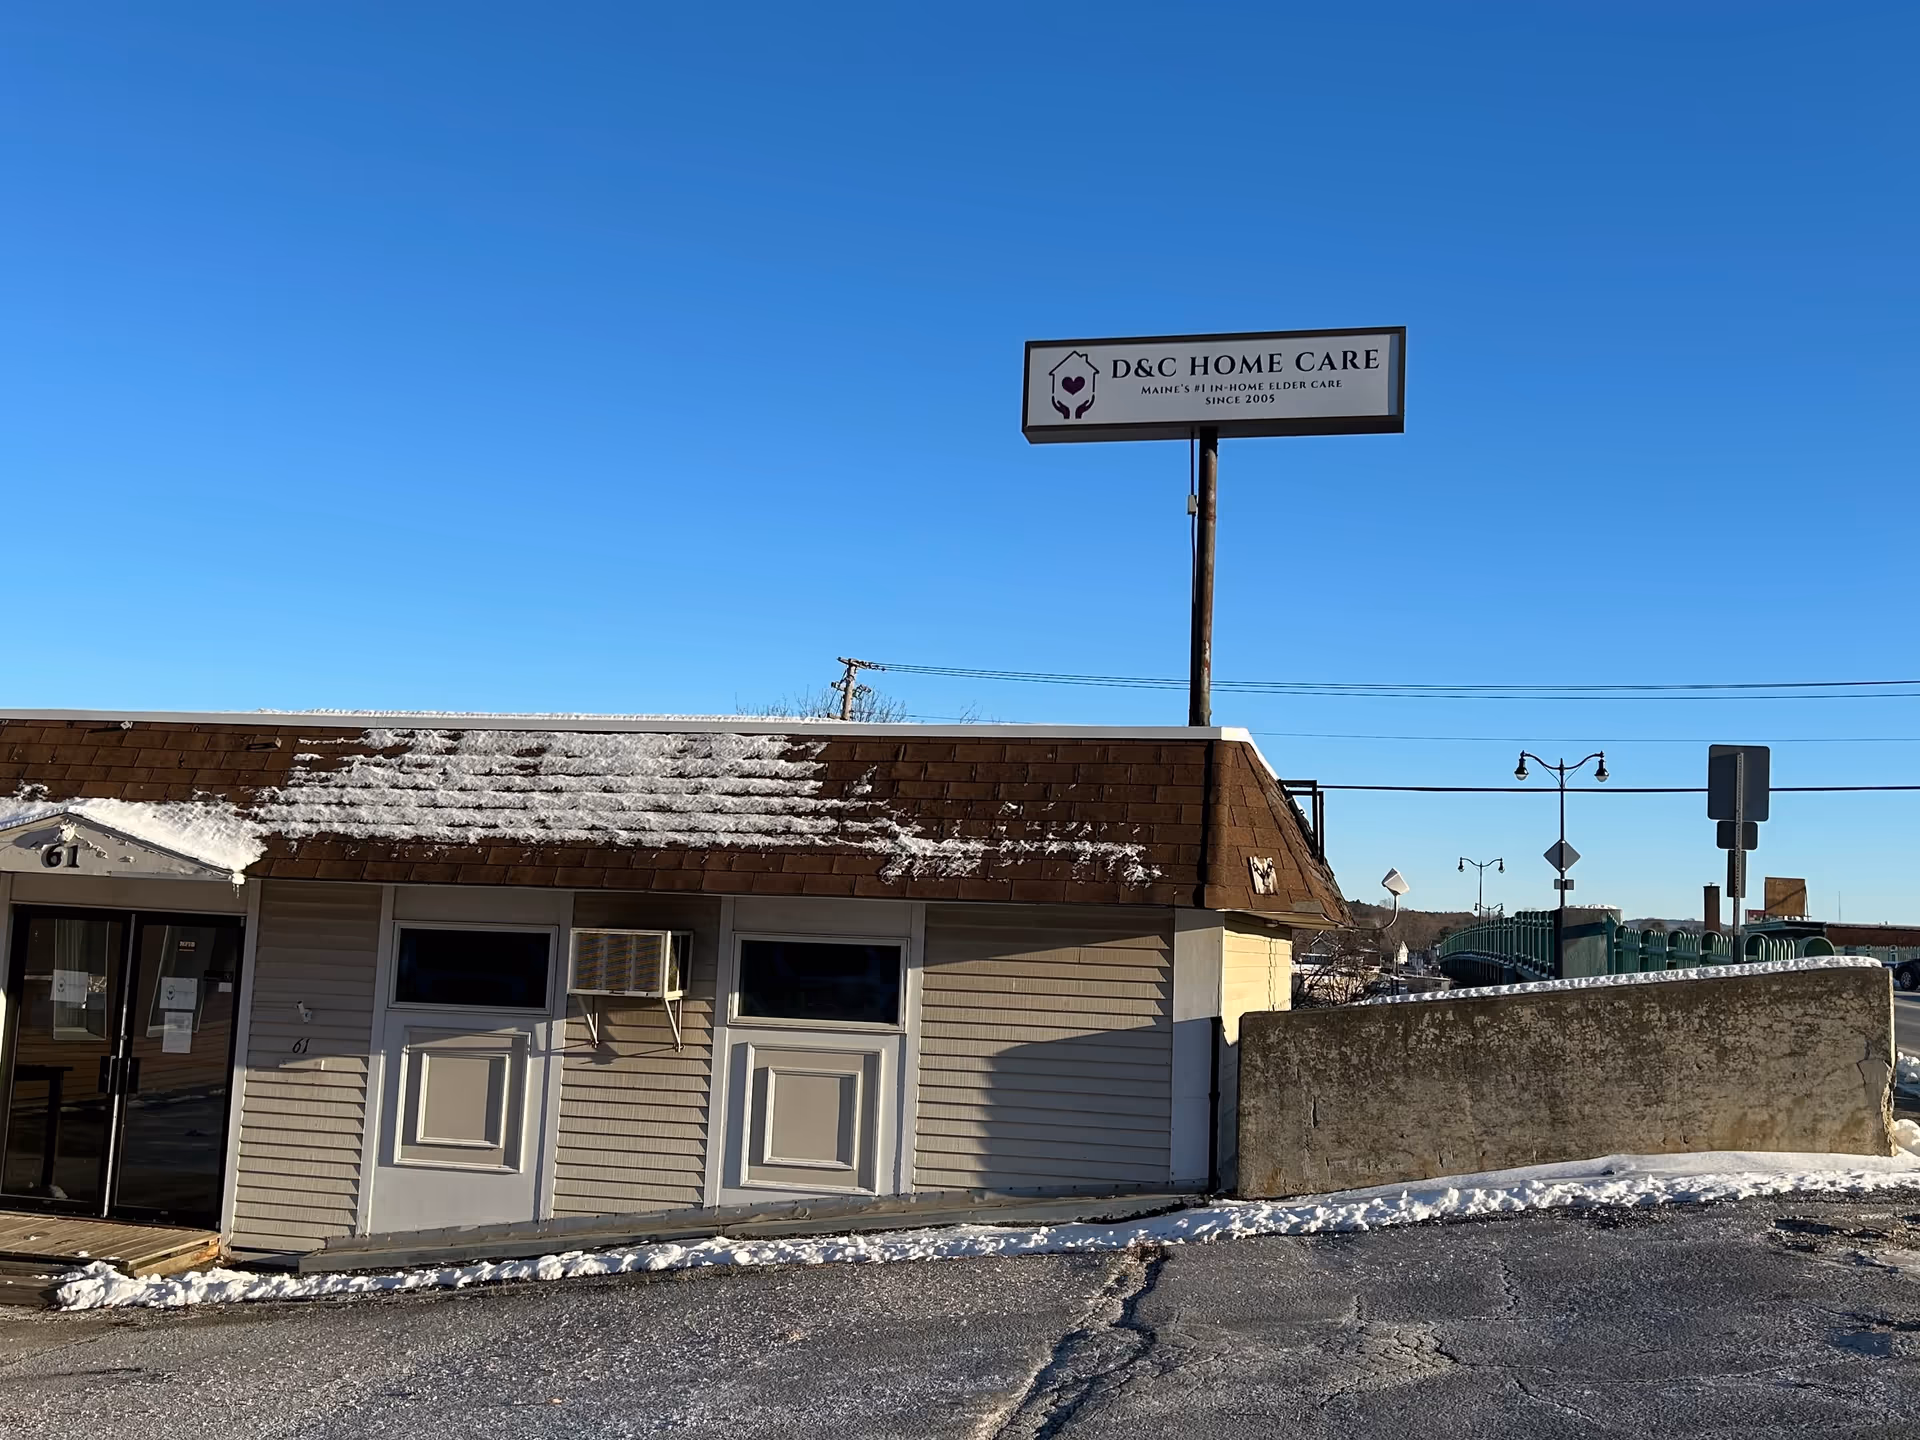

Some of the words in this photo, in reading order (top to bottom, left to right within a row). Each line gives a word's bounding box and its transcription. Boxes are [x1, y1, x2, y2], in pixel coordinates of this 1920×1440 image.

[1112, 357, 1177, 379] D&C
[1190, 353, 1283, 376] HOME
[1295, 349, 1380, 372] CARE
[1141, 384, 1190, 395] MAINE'S
[1210, 382, 1264, 392] IN-HOME
[1269, 381, 1306, 391] ELDER
[1310, 380, 1343, 388] CARE
[1205, 396, 1241, 405] SINCE
[1245, 394, 1275, 404] 2005
[41, 843, 80, 868] 61
[292, 1037, 311, 1054] 61
